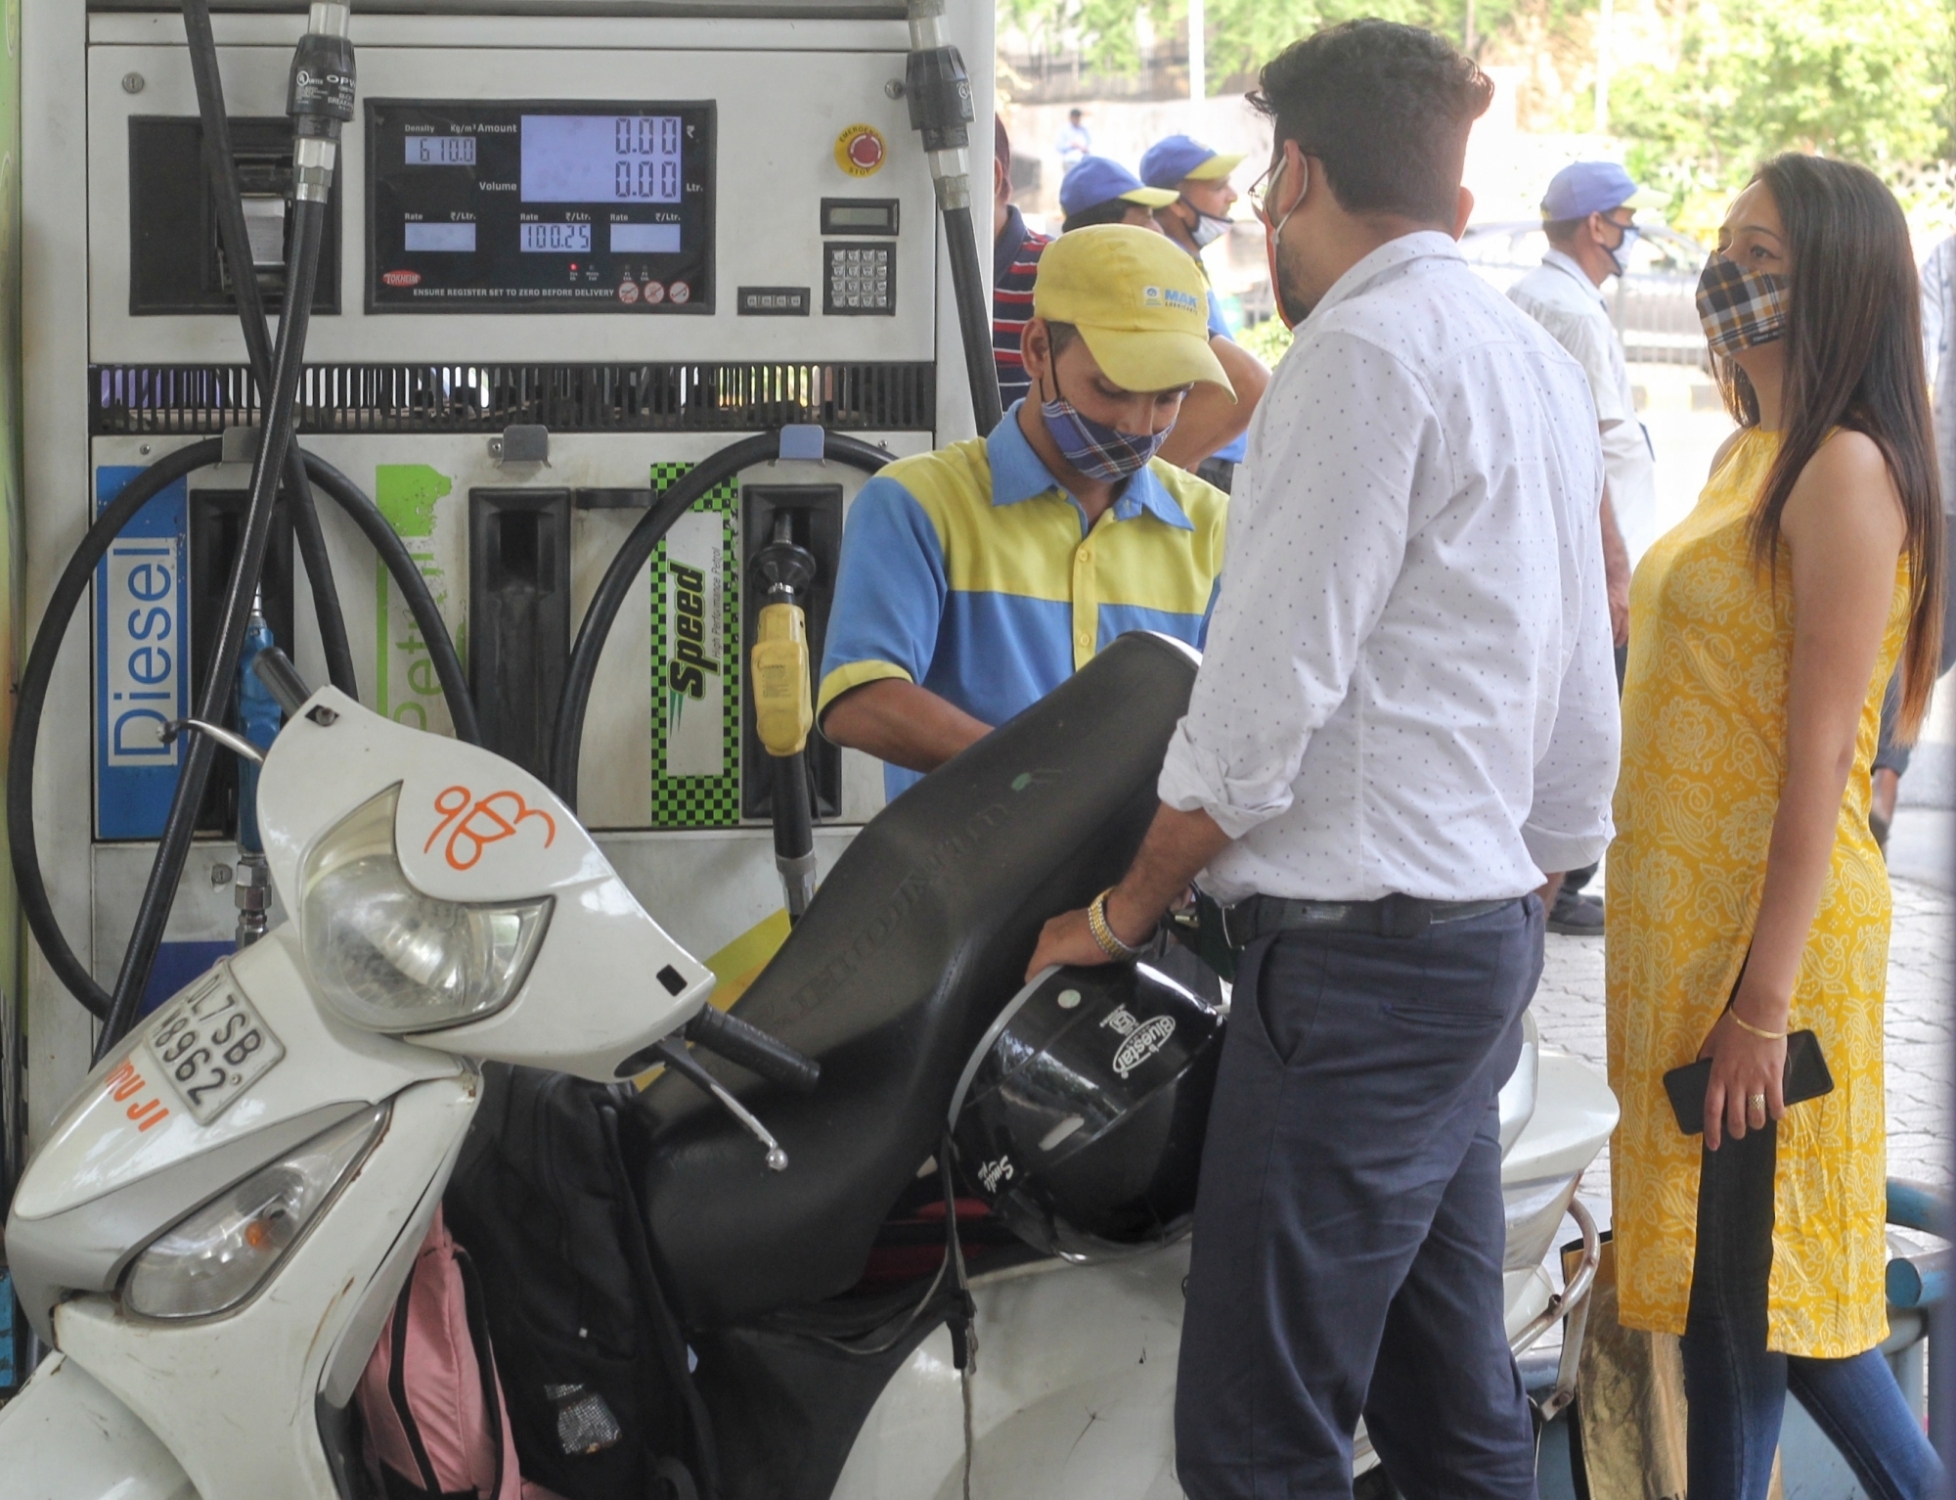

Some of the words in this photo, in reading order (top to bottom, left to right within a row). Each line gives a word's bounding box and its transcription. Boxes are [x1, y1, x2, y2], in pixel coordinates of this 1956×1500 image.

[405, 124, 434, 134] Density
[477, 122, 517, 133] Amount
[839, 126, 879, 143] EMERGEN
[615, 118, 677, 155] 0.00
[479, 181, 517, 192] Volume
[615, 160, 677, 198] 0.00
[686, 182, 704, 193] Ltr.
[405, 213, 423, 221] Rate
[520, 213, 539, 221] Rate
[610, 213, 629, 221] Rate
[526, 225, 590, 249] 100.25
[413, 288, 445, 297] ENSURE
[447, 288, 486, 297] REGISTER
[489, 288, 503, 297] SET
[506, 288, 516, 297] TO
[519, 288, 540, 297] ZERO
[542, 288, 572, 297] BEFORE
[575, 288, 614, 297] DELIVERY
[1165, 289, 1198, 308] MAK
[668, 559, 721, 699] Speed
[112, 547, 172, 756] Diesel
[1117, 1016, 1175, 1072] Bluestar
[126, 1098, 169, 1132] JI
